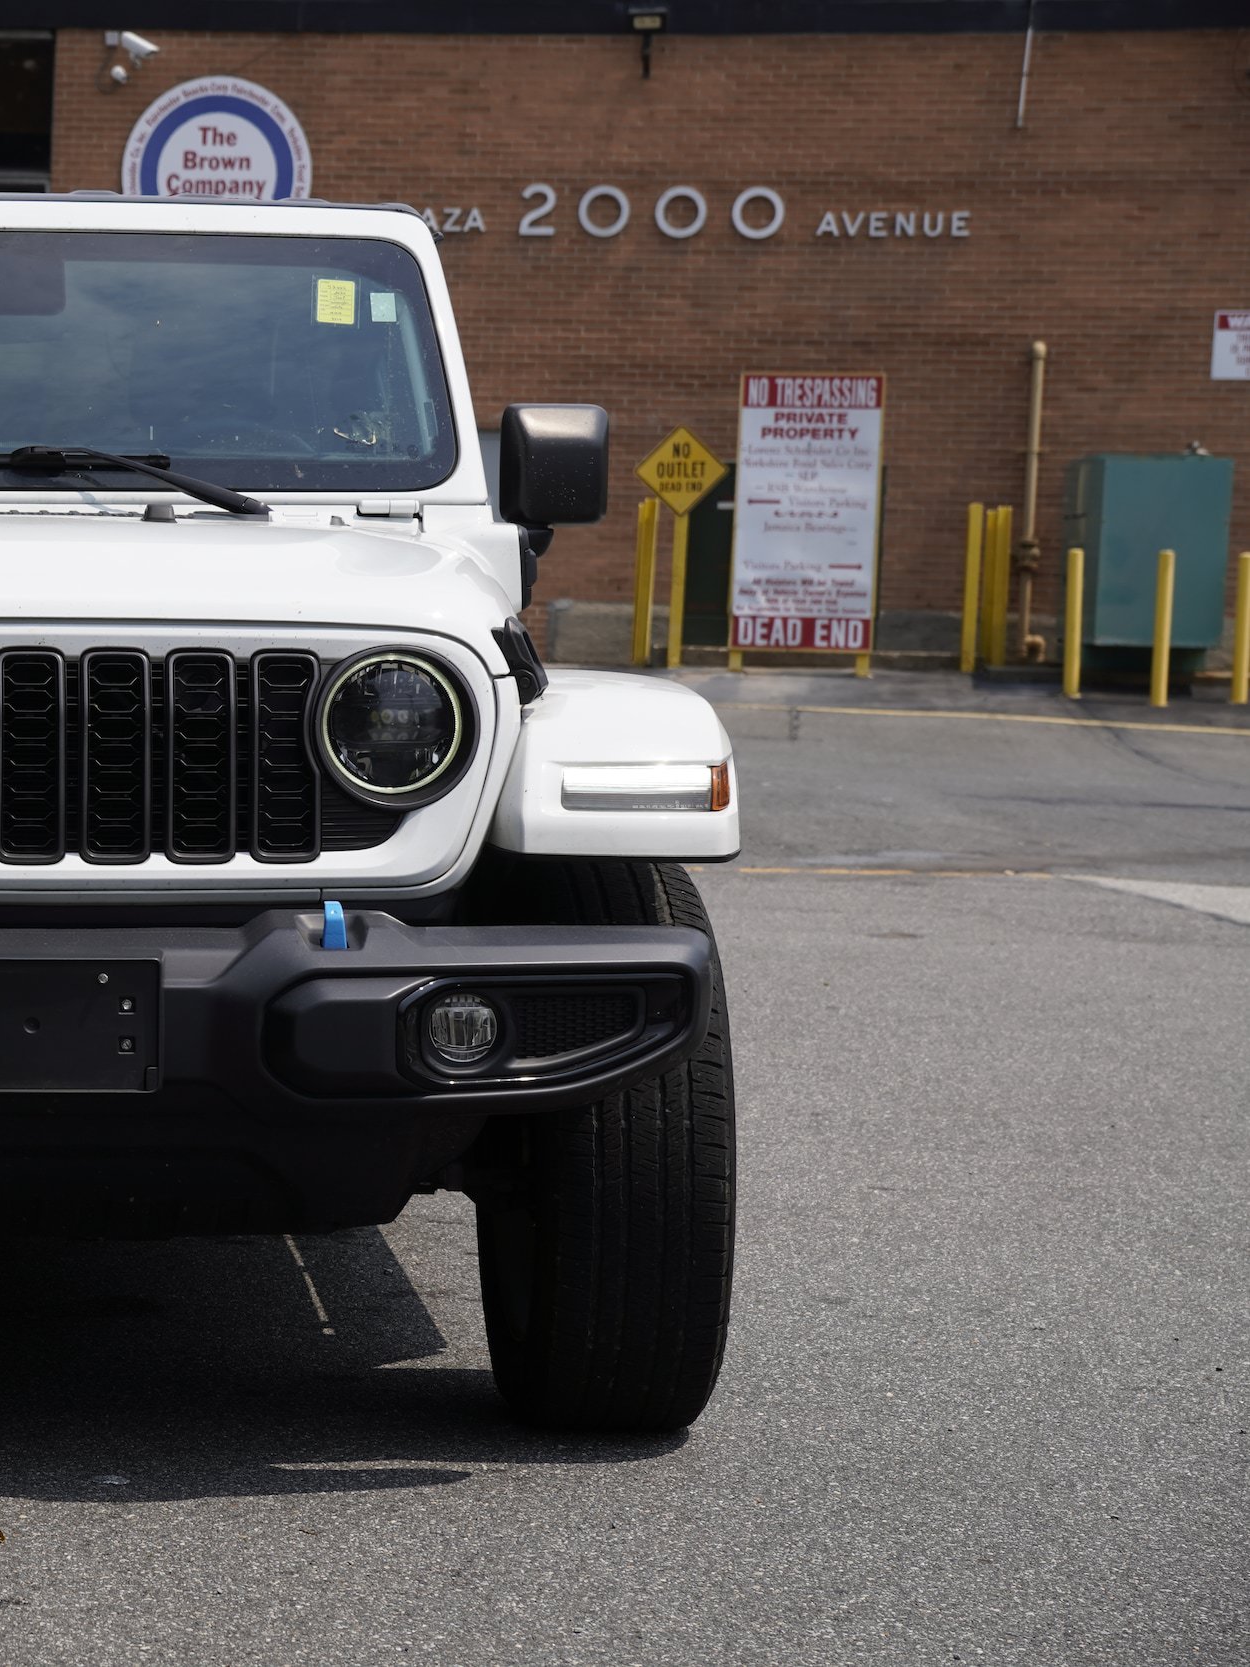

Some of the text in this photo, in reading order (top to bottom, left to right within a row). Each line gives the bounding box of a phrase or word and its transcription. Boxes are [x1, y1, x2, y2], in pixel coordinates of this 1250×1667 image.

[199, 126, 238, 146] The
[183, 150, 251, 171] Brown
[166, 174, 266, 199] Company
[518, 182, 785, 240] 2000
[815, 211, 971, 237] AVENUE
[748, 377, 877, 407] NO TRESPASSING
[774, 412, 849, 425] PRIVATE
[760, 427, 859, 441] PROPERTY
[672, 442, 691, 459] NO
[656, 461, 706, 479] OUTLET
[659, 480, 703, 493] DEAD END
[829, 497, 868, 511] Parking
[738, 617, 863, 648] DEAD END
